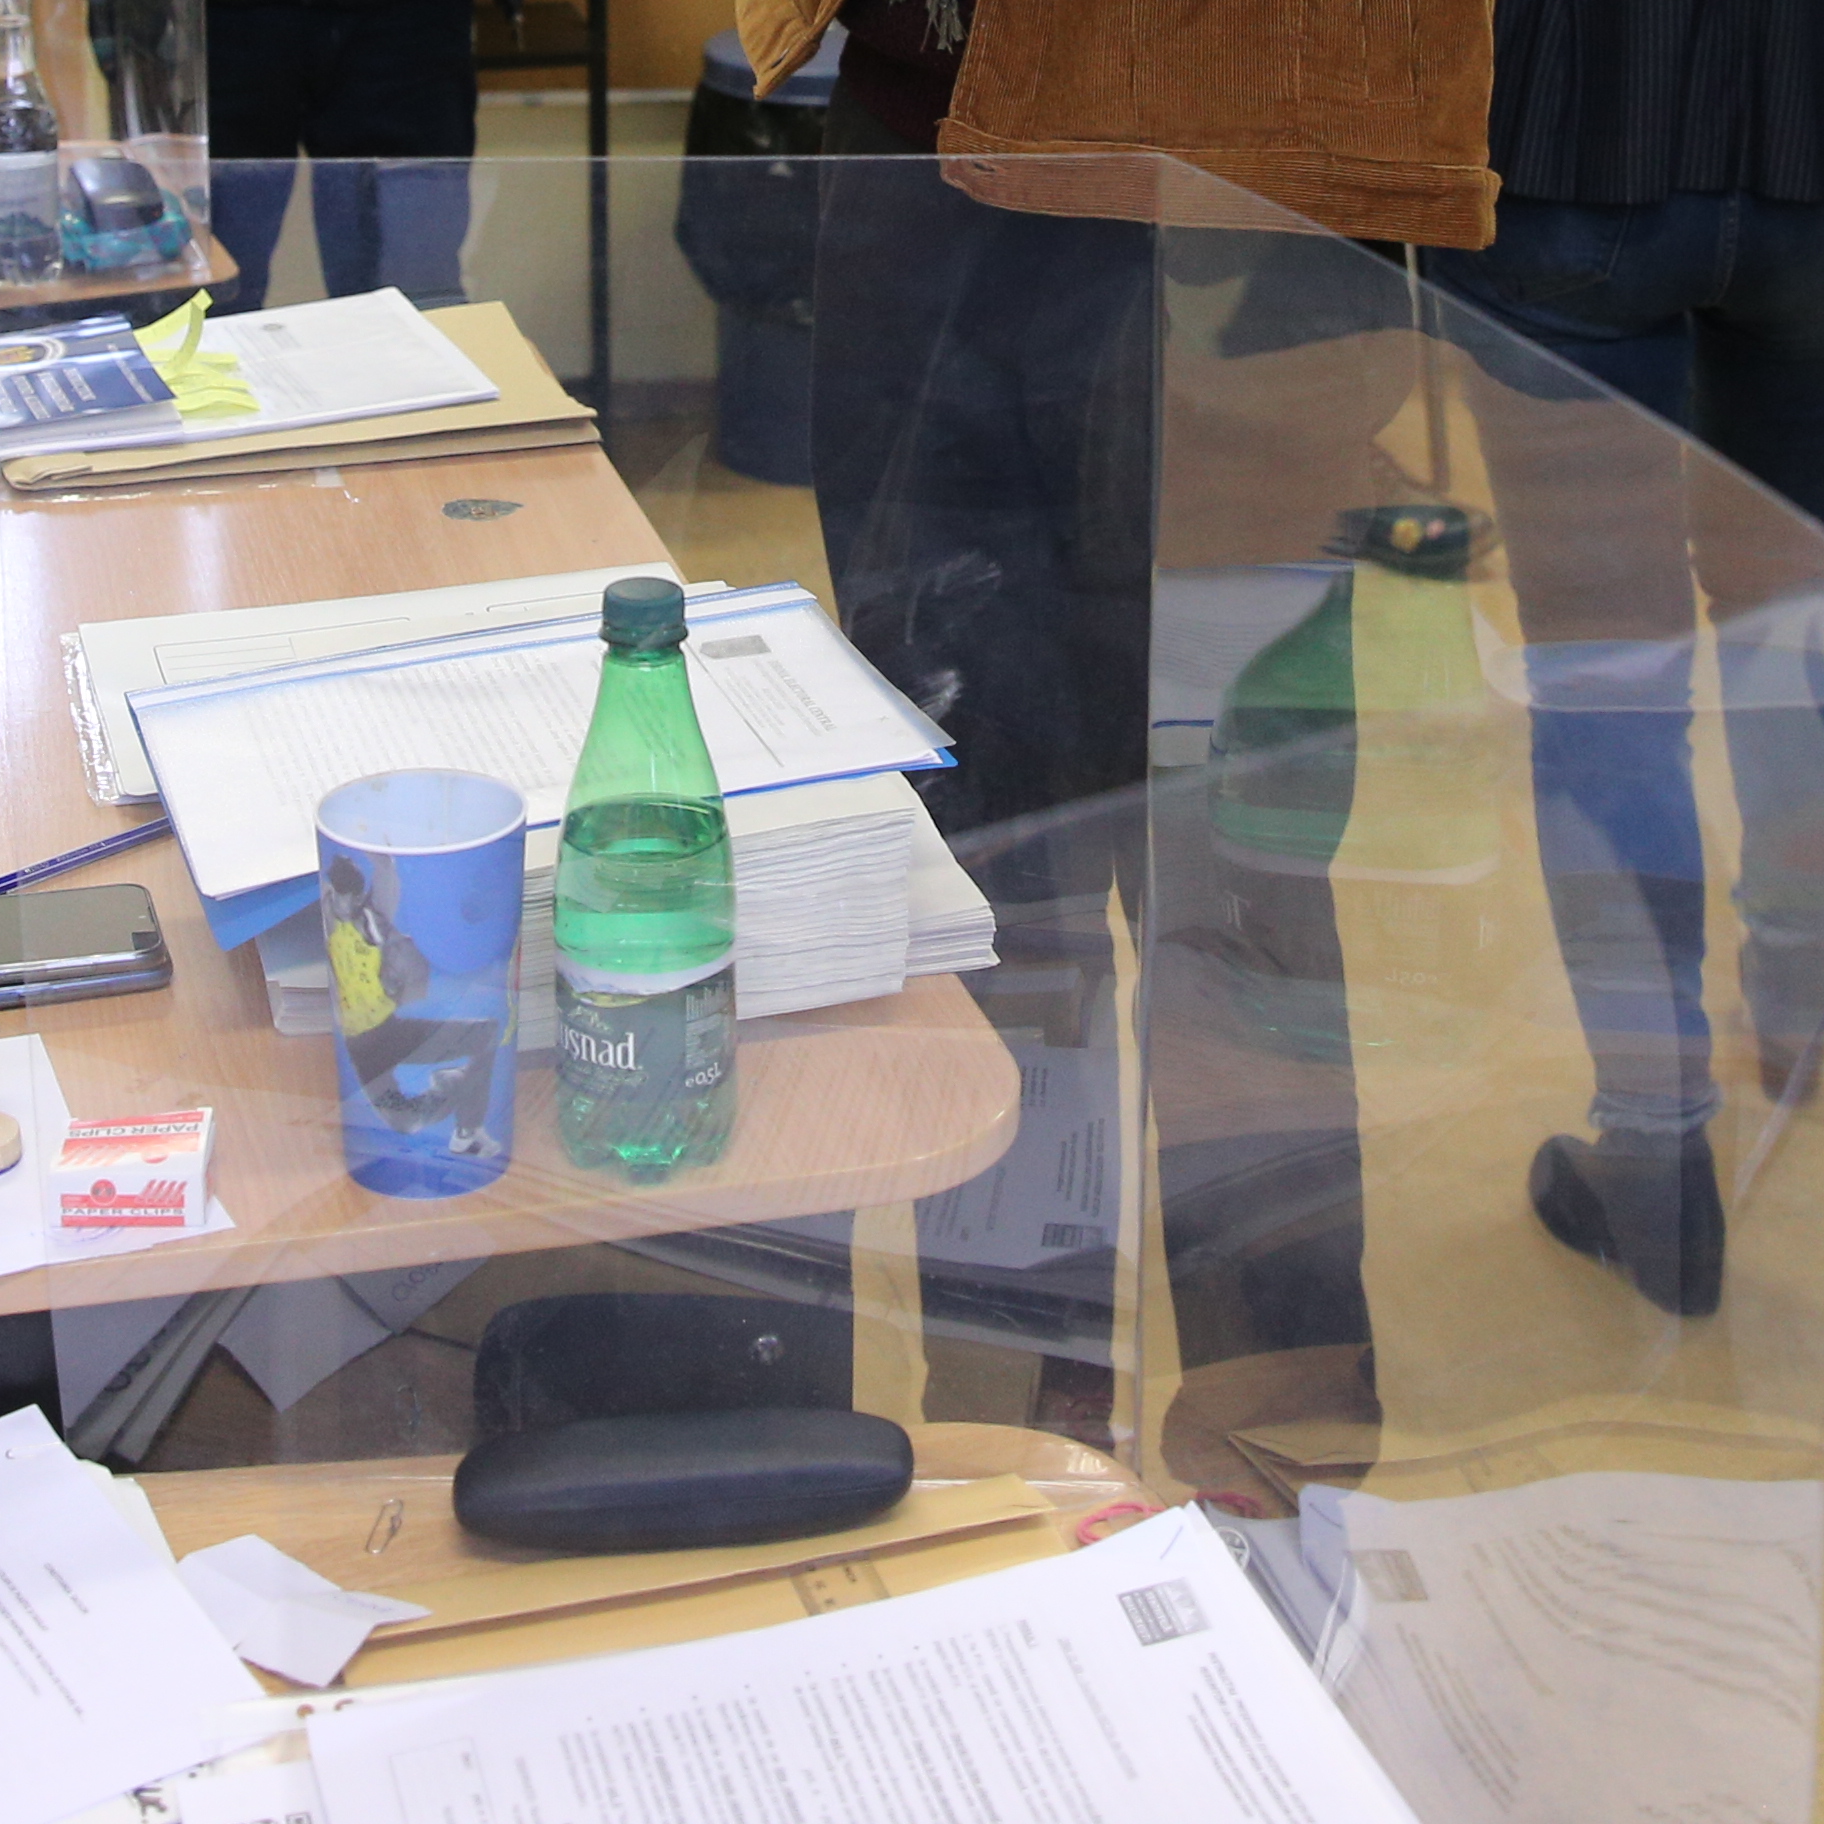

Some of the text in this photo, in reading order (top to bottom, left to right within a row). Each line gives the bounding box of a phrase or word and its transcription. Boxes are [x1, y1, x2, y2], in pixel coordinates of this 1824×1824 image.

[69, 1123, 198, 1137] PAPER CLIPS
[61, 1207, 184, 1215] PAPER CLIPS
